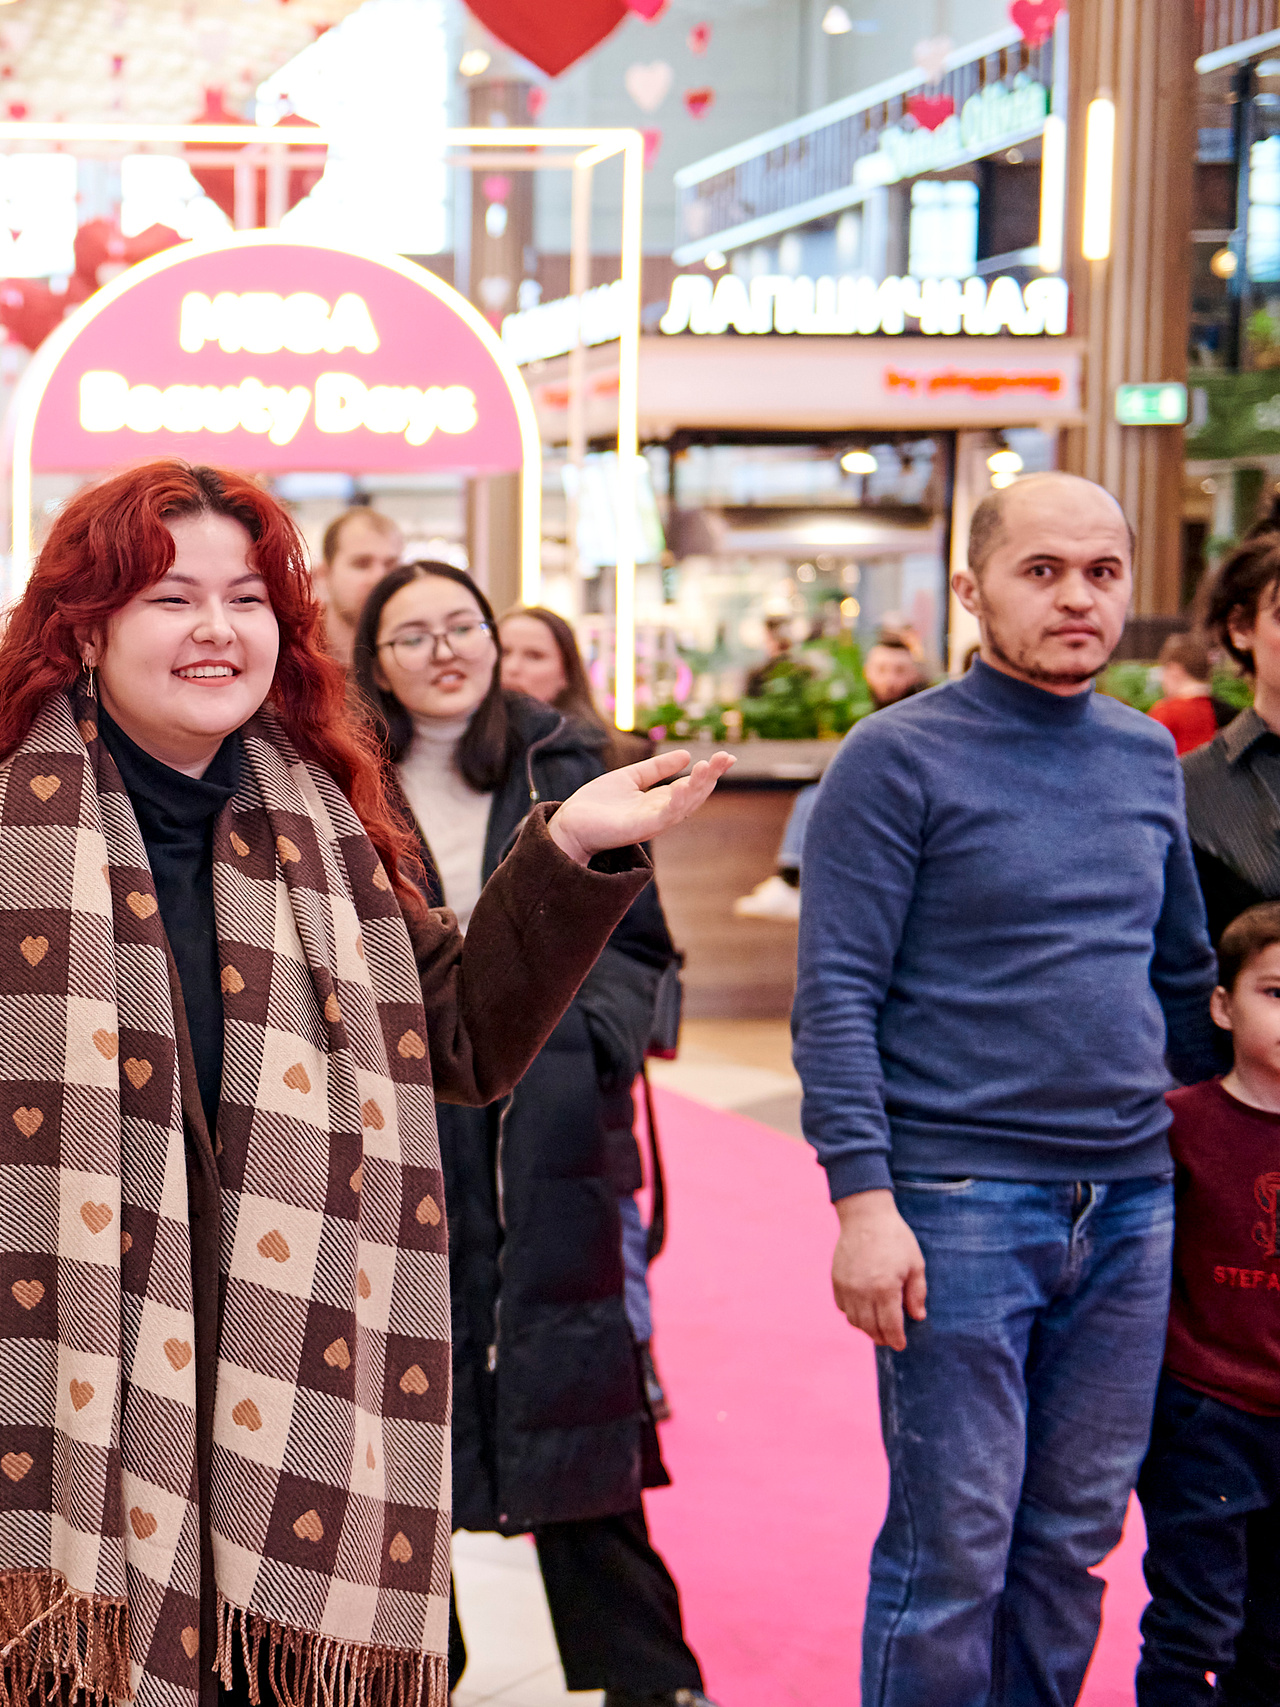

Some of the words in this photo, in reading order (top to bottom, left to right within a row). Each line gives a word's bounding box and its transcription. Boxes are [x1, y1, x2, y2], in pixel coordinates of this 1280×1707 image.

[179, 291, 380, 354] MEGA
[660, 274, 1069, 335] ЛАПШИЧНАЯ
[79, 370, 313, 446] Beauty
[314, 371, 478, 446] Days
